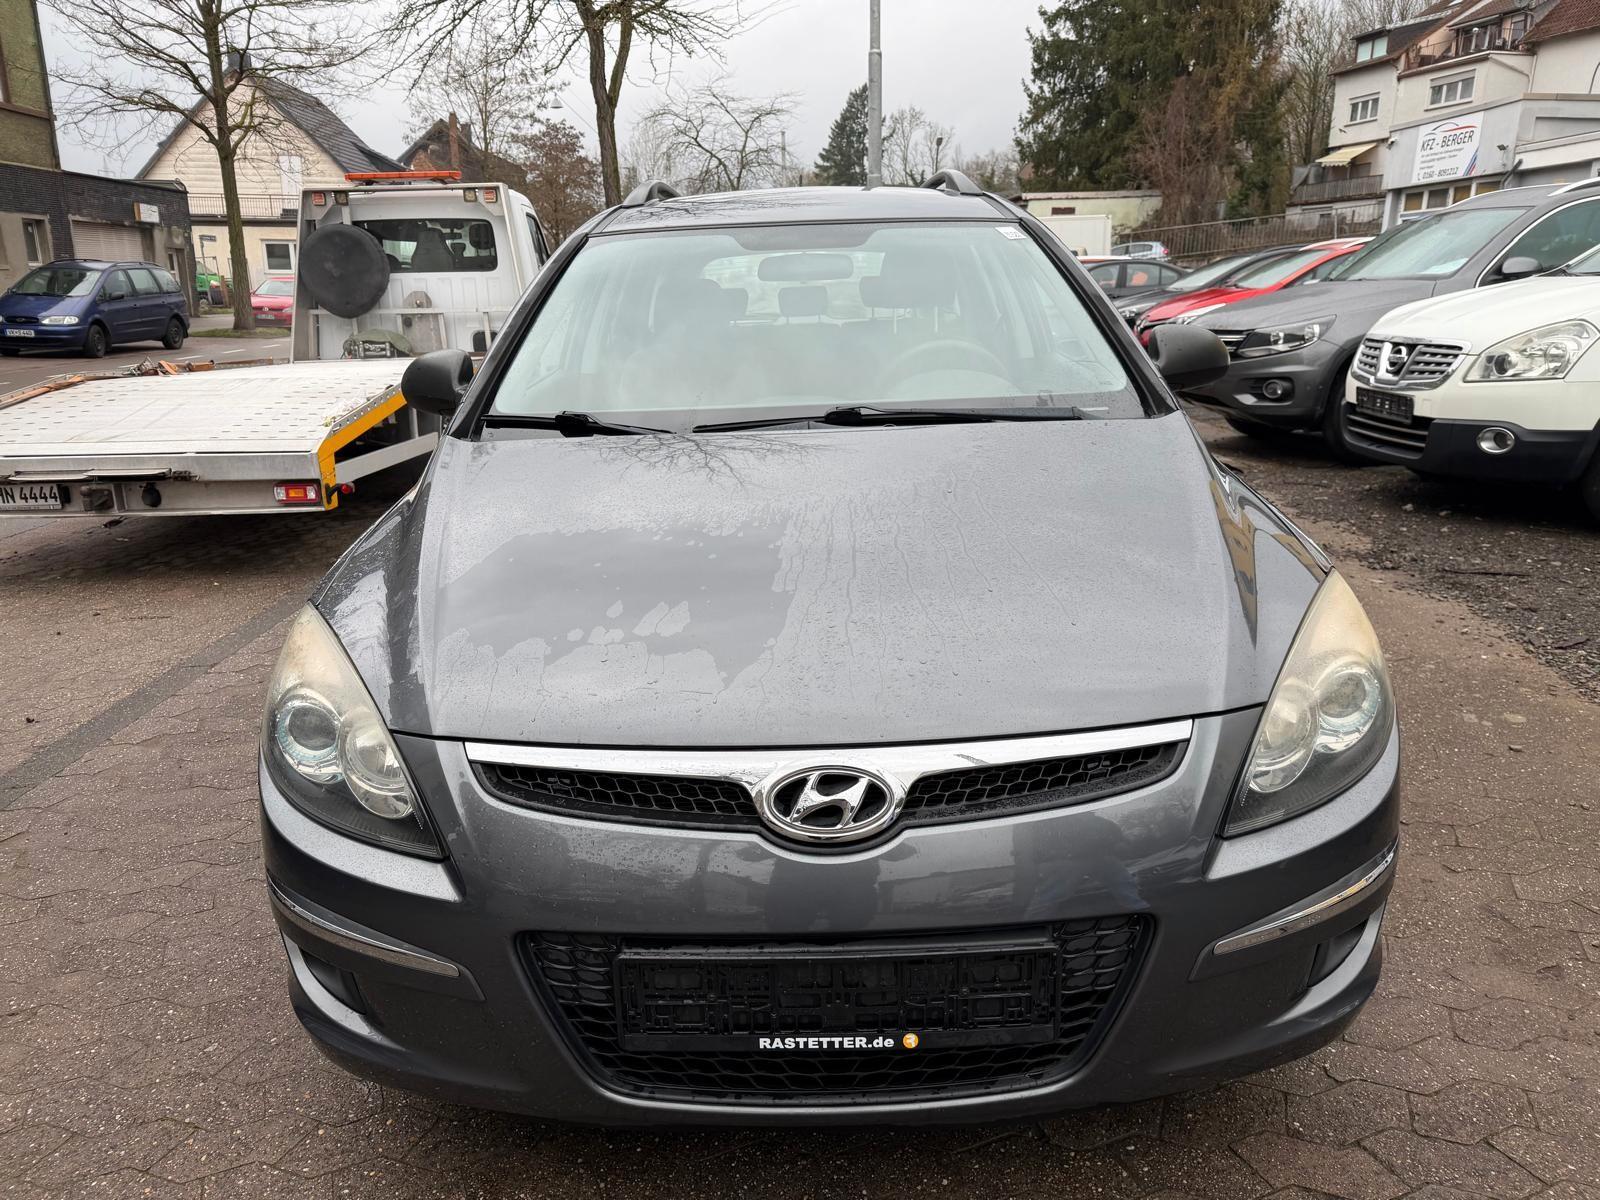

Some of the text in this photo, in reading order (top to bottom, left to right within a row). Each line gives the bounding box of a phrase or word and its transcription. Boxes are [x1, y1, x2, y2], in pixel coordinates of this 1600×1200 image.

[1421, 138, 1436, 152] KFZ
[1441, 130, 1475, 148] BERGER
[20, 486, 58, 503] 4444
[759, 1036, 895, 1049] RASTETTER.de
